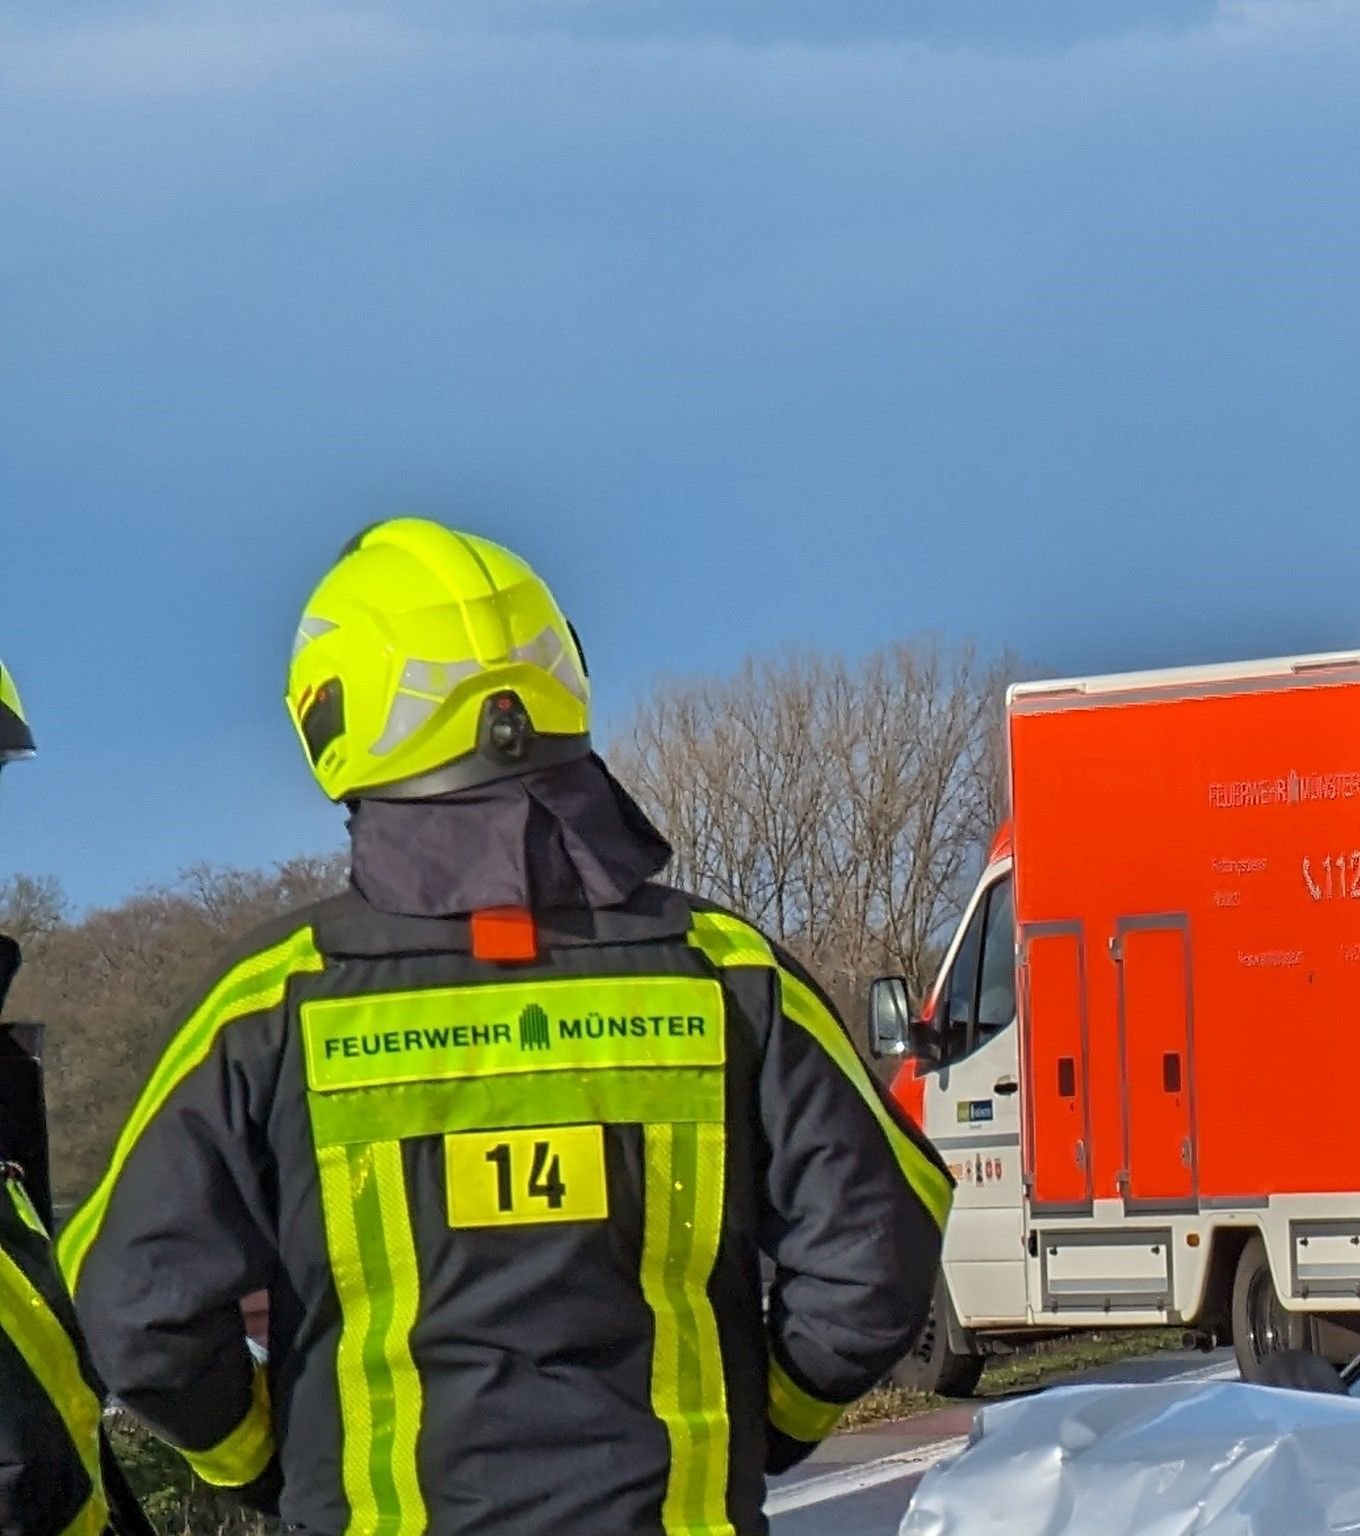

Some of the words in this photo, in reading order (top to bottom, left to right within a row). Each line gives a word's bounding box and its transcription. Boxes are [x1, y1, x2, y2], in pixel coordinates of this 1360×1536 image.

[325, 1023, 511, 1060] FEUERWEHR
[559, 1012, 706, 1040] MÜNSTER
[486, 1141, 566, 1213] 14
